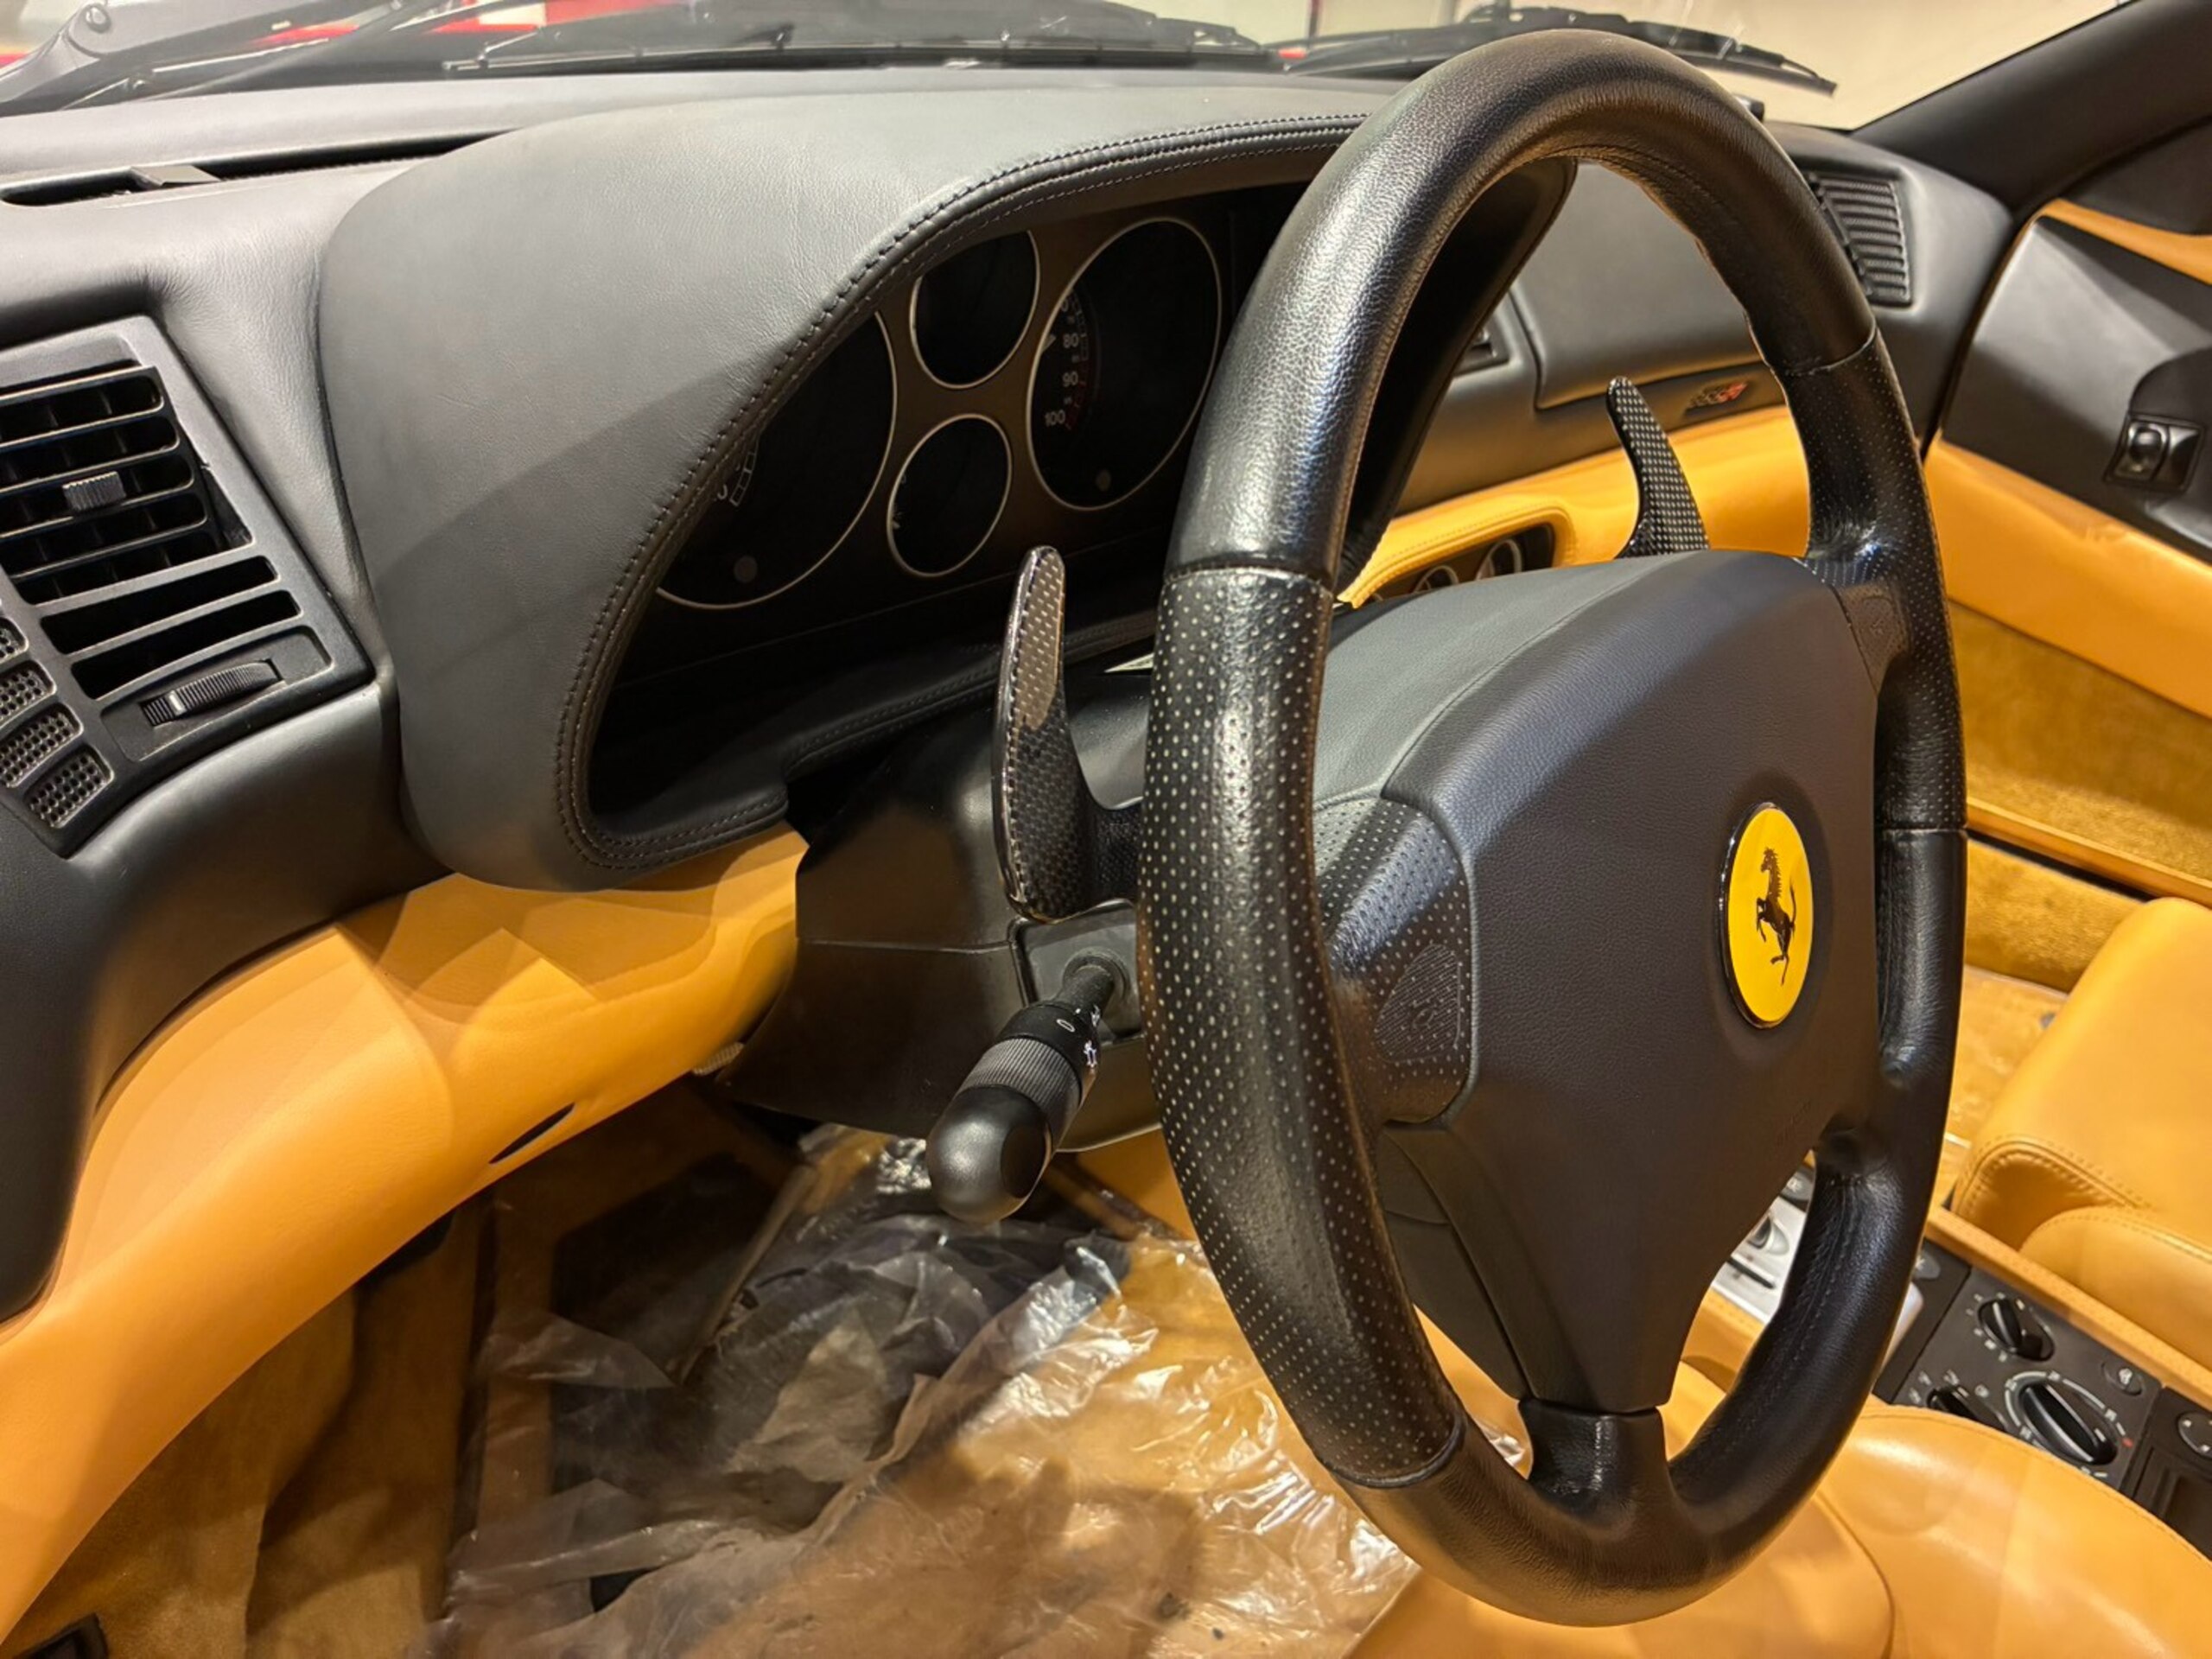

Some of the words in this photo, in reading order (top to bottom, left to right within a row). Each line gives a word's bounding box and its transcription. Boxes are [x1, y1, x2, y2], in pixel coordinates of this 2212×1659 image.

[1063, 334, 1079, 348] 80
[1063, 372, 1078, 387] 90
[1045, 410, 1065, 427] 100
